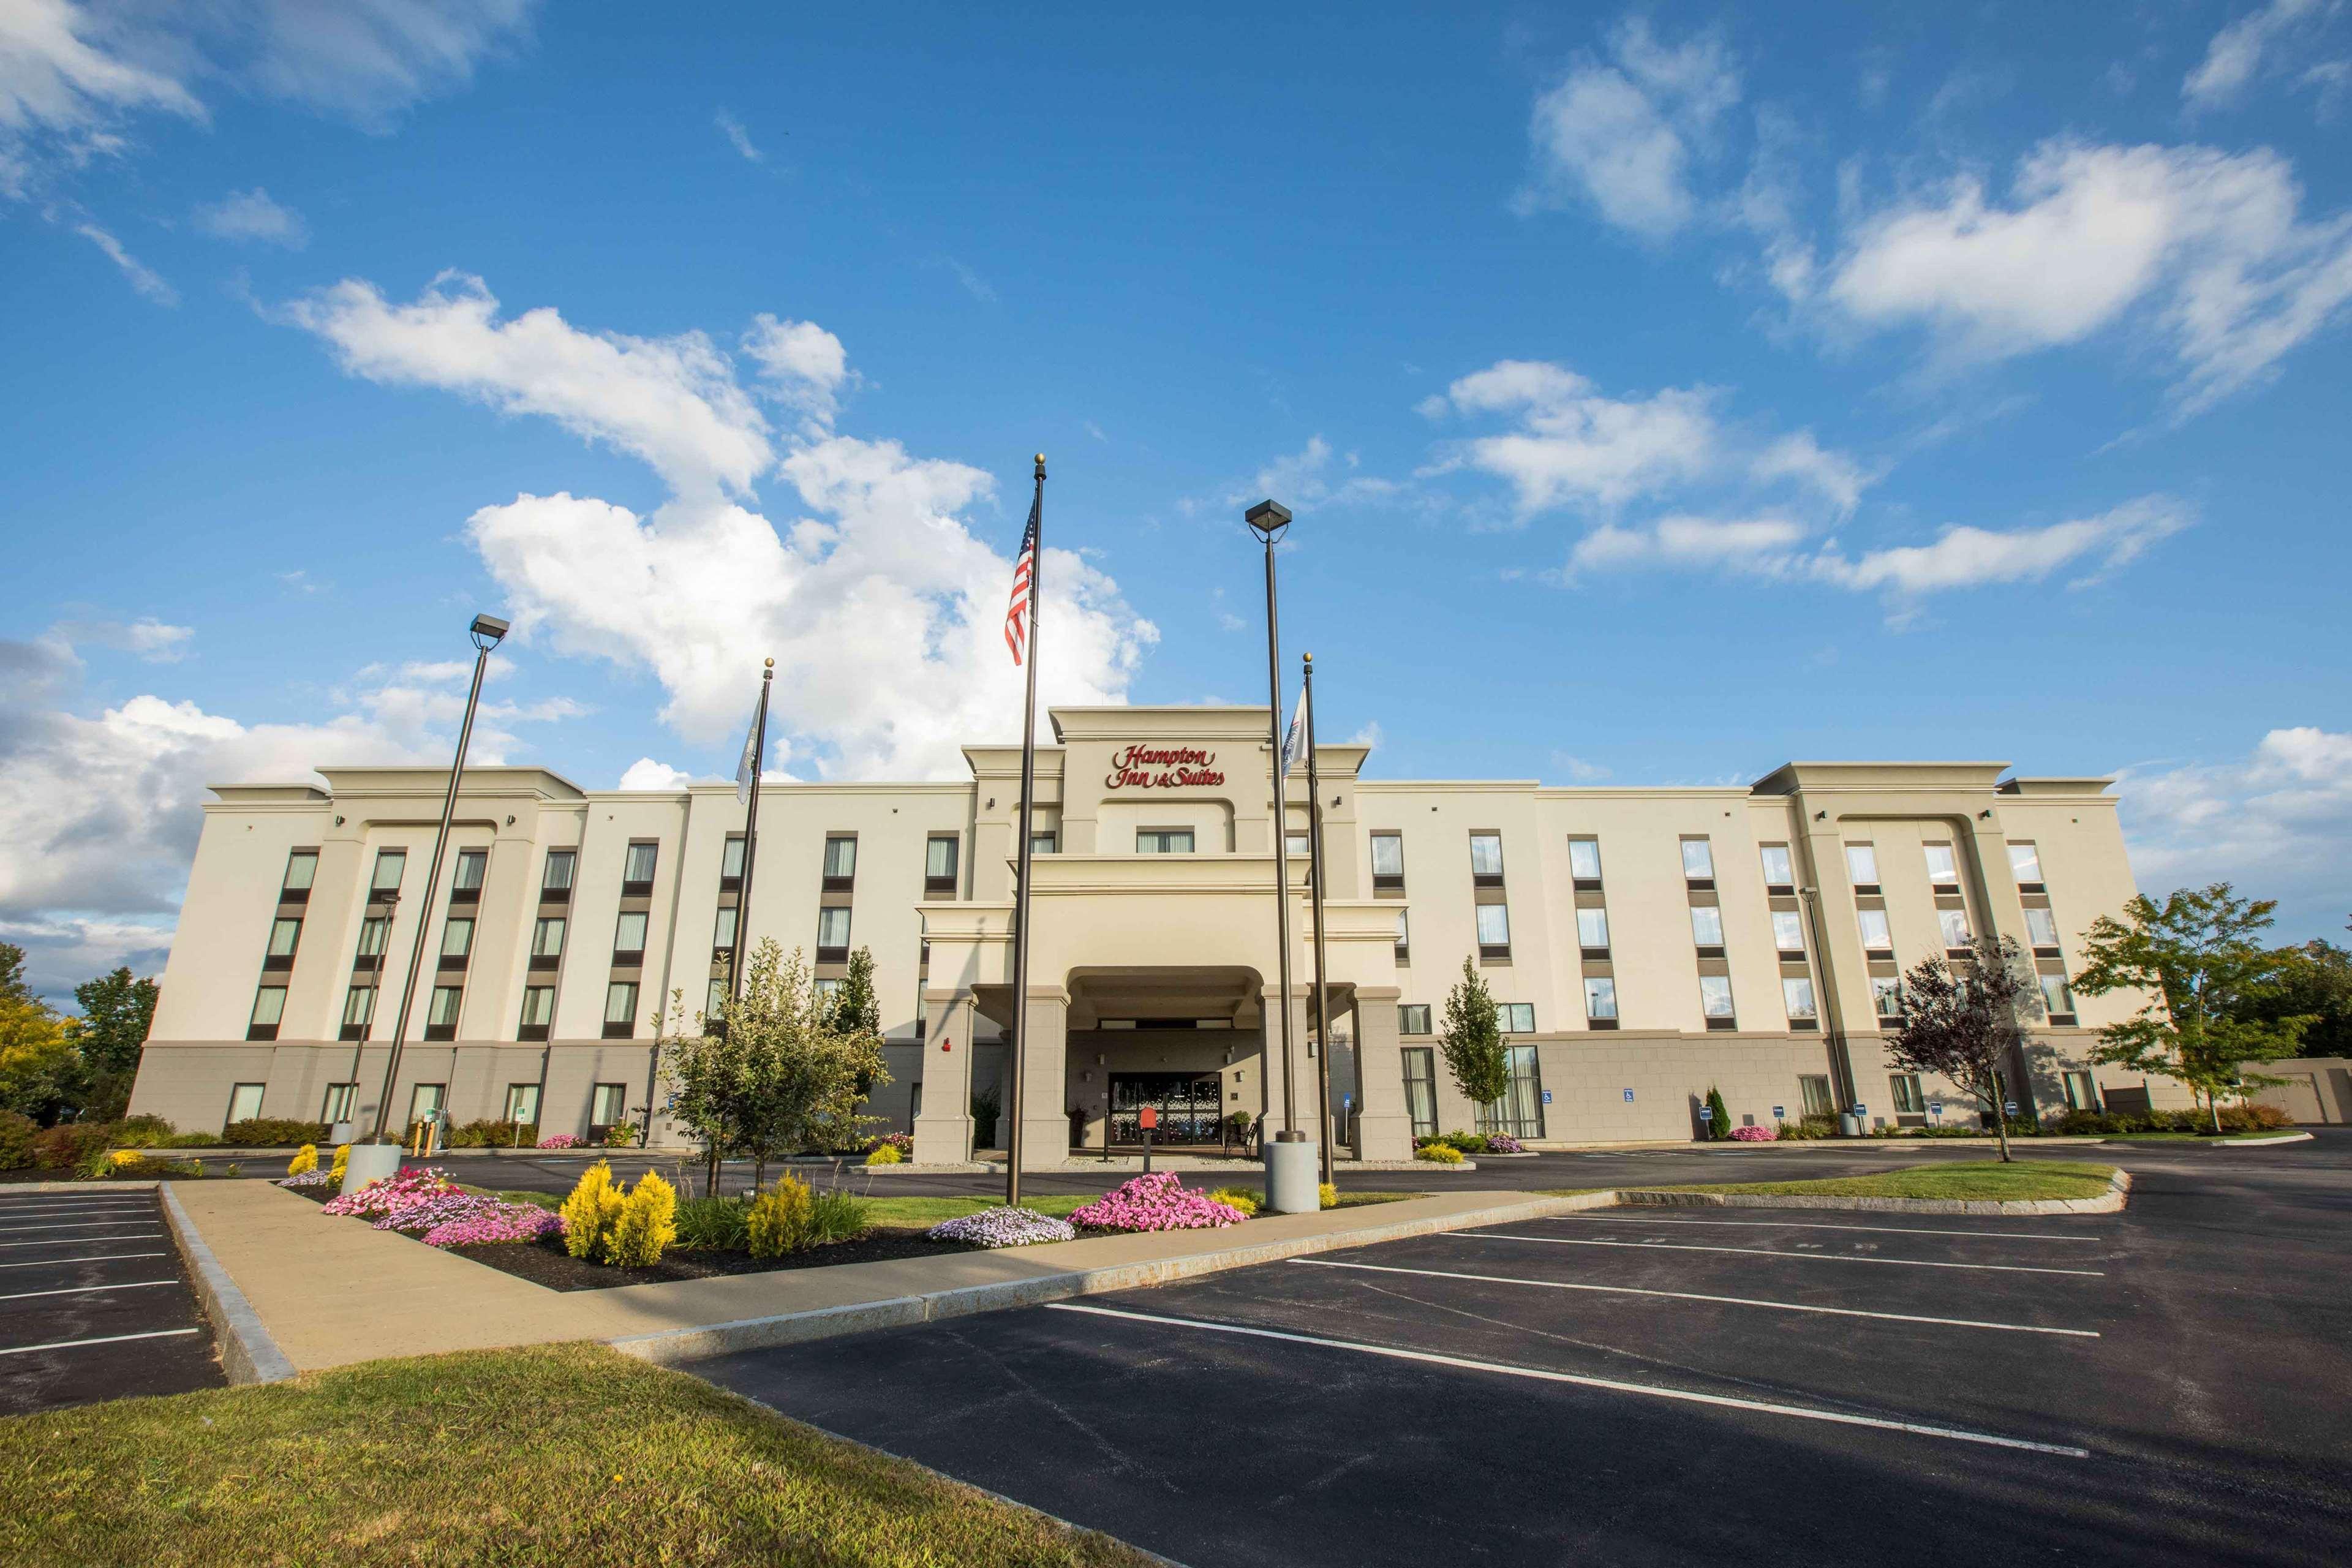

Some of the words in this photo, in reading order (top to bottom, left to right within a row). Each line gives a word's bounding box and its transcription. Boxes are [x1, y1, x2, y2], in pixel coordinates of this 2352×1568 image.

[1112, 744, 1215, 769] Hampton
[1106, 767, 1158, 789] Inn
[1158, 772, 1171, 788] &
[1170, 767, 1225, 786] Suites
